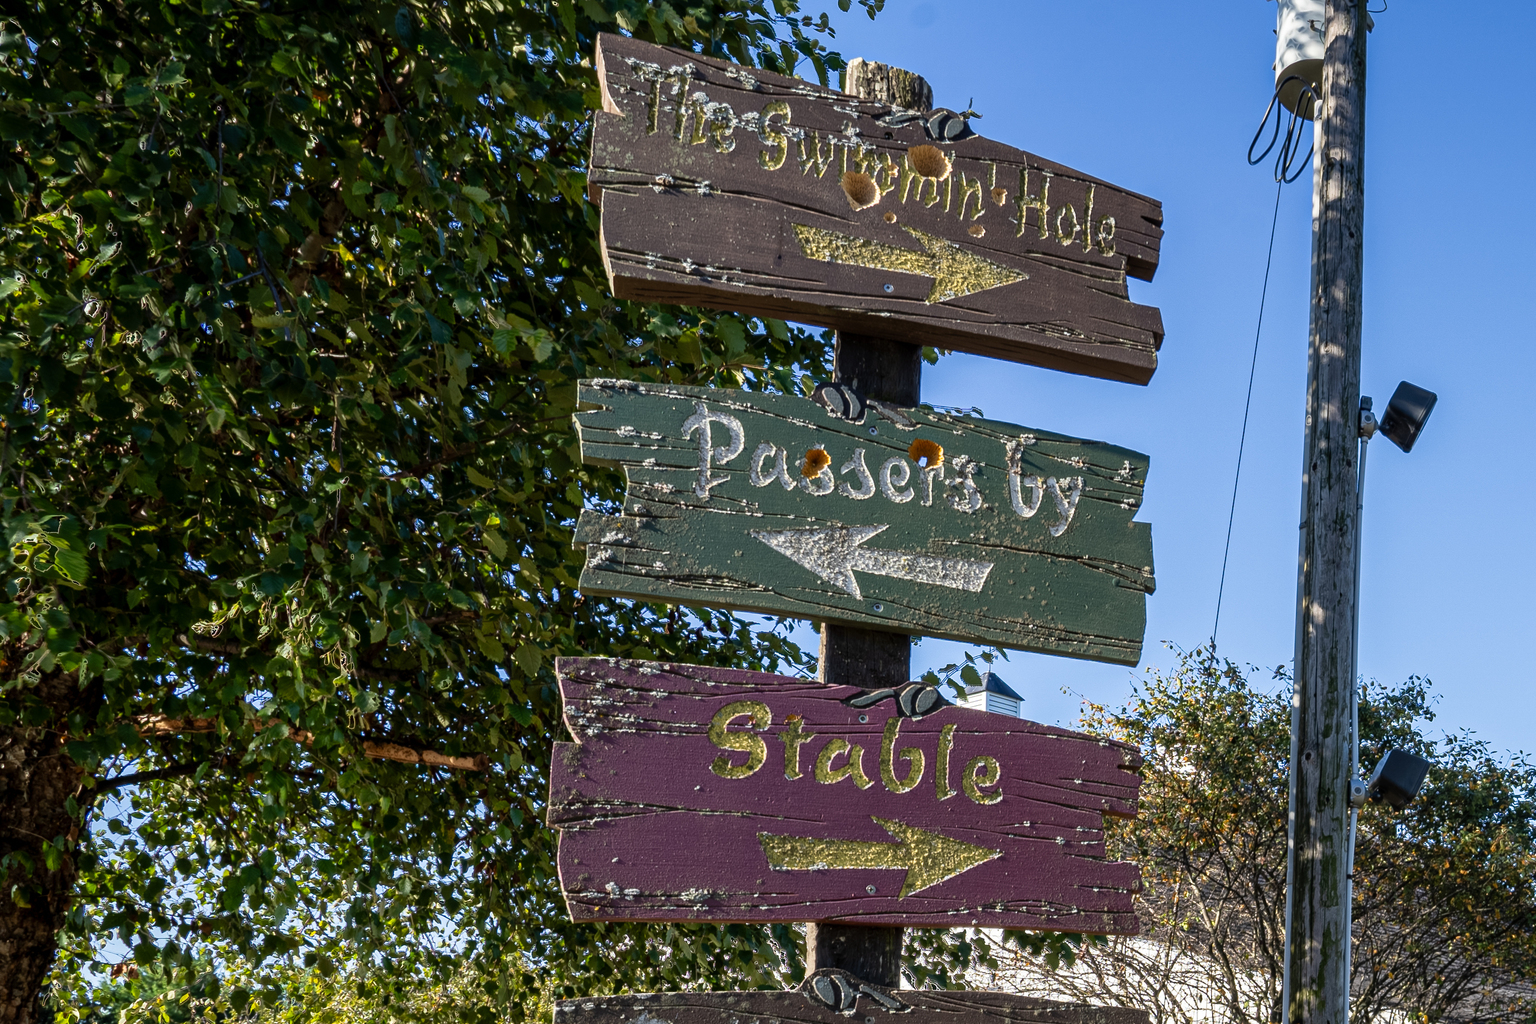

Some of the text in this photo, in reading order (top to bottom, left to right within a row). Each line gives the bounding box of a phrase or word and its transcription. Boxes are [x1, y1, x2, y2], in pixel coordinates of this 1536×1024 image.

[625, 57, 736, 153] The
[1012, 161, 1117, 258] Hole
[681, 402, 1085, 537] Passers by
[707, 701, 1003, 804] Stable
